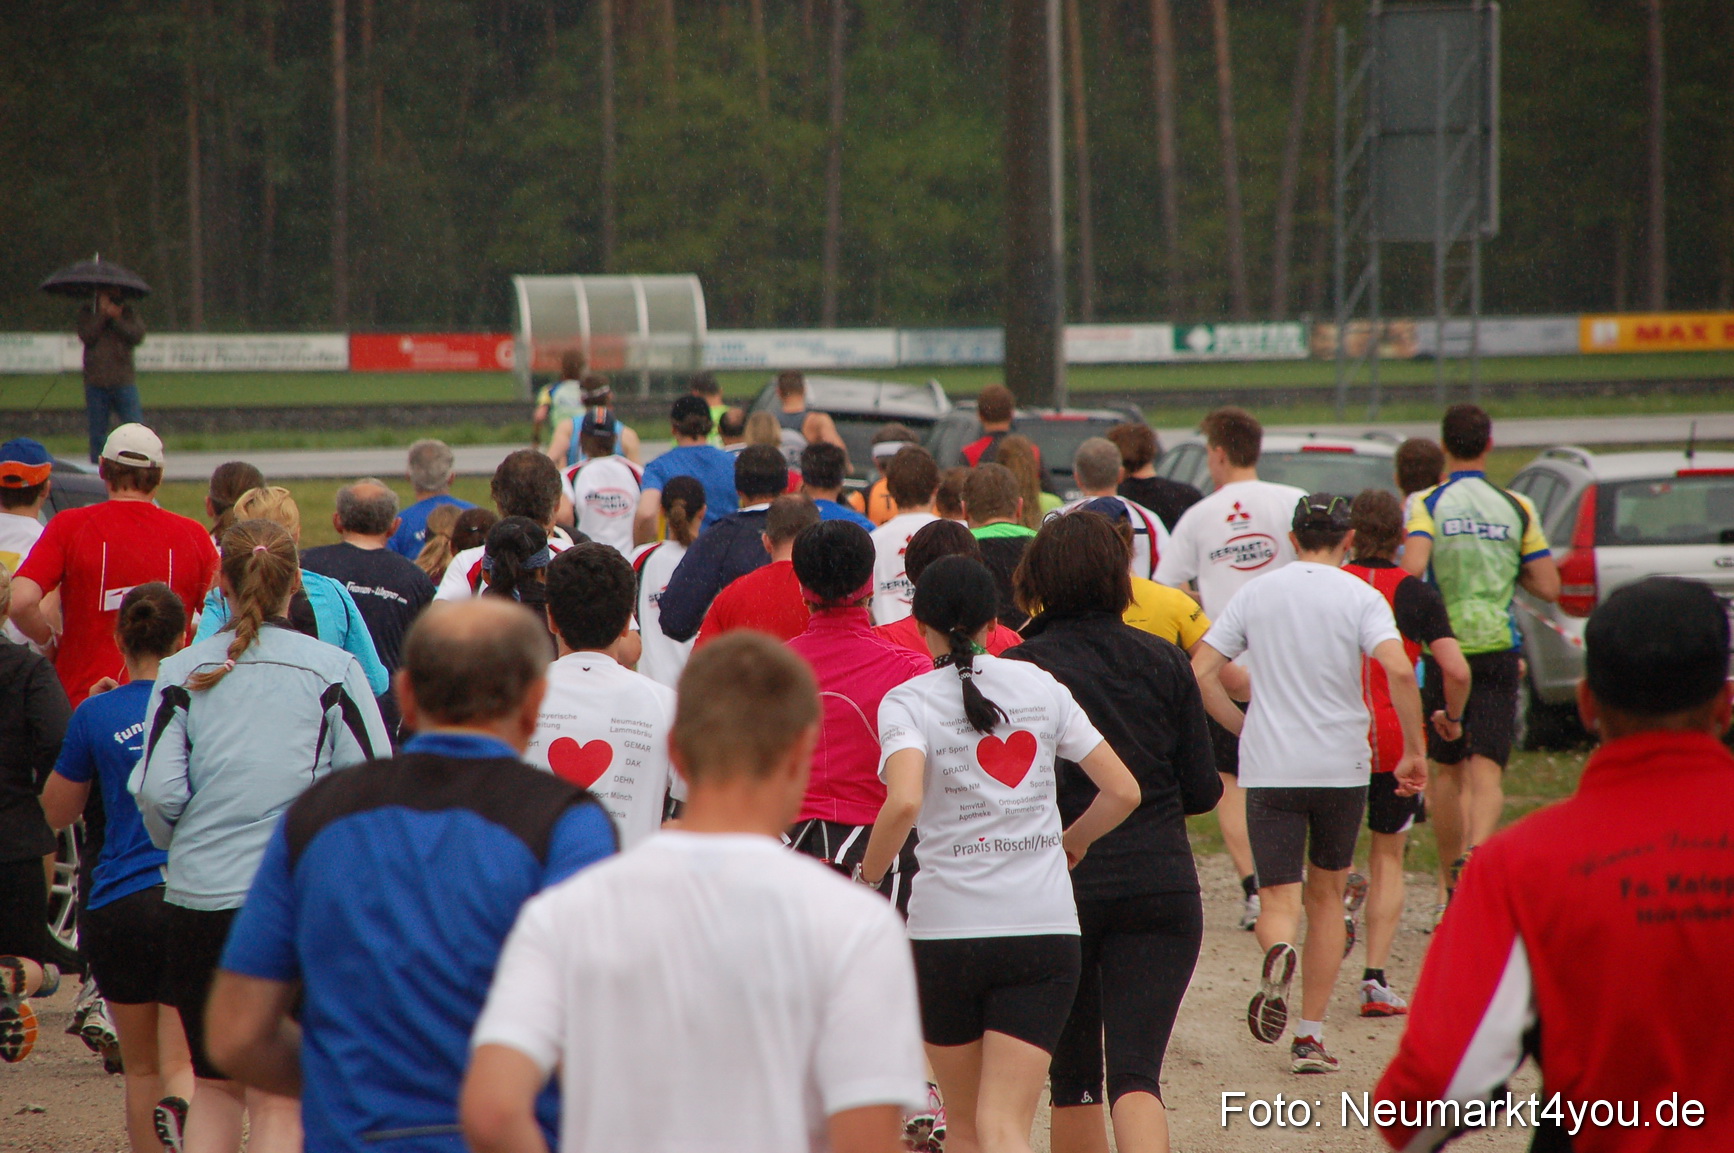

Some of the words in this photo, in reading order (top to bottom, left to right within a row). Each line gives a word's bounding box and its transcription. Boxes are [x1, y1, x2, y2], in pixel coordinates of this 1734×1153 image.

[1636, 324, 1707, 341] MAX
[536, 721, 561, 730] eitung
[610, 717, 653, 729] Neumarkter
[609, 726, 653, 738] Lammsbräu
[624, 740, 652, 753] GEMAR
[936, 748, 946, 756] MF
[949, 745, 969, 754] Sport
[625, 758, 642, 768] DAK
[942, 764, 970, 775] GRADU
[613, 775, 635, 785] DEHN
[944, 784, 968, 794] Physio
[968, 783, 981, 791] NM
[610, 791, 633, 801] Münch
[960, 801, 986, 811] Nmvital
[959, 811, 992, 821] Apotheke
[953, 837, 991, 857] Praxis
